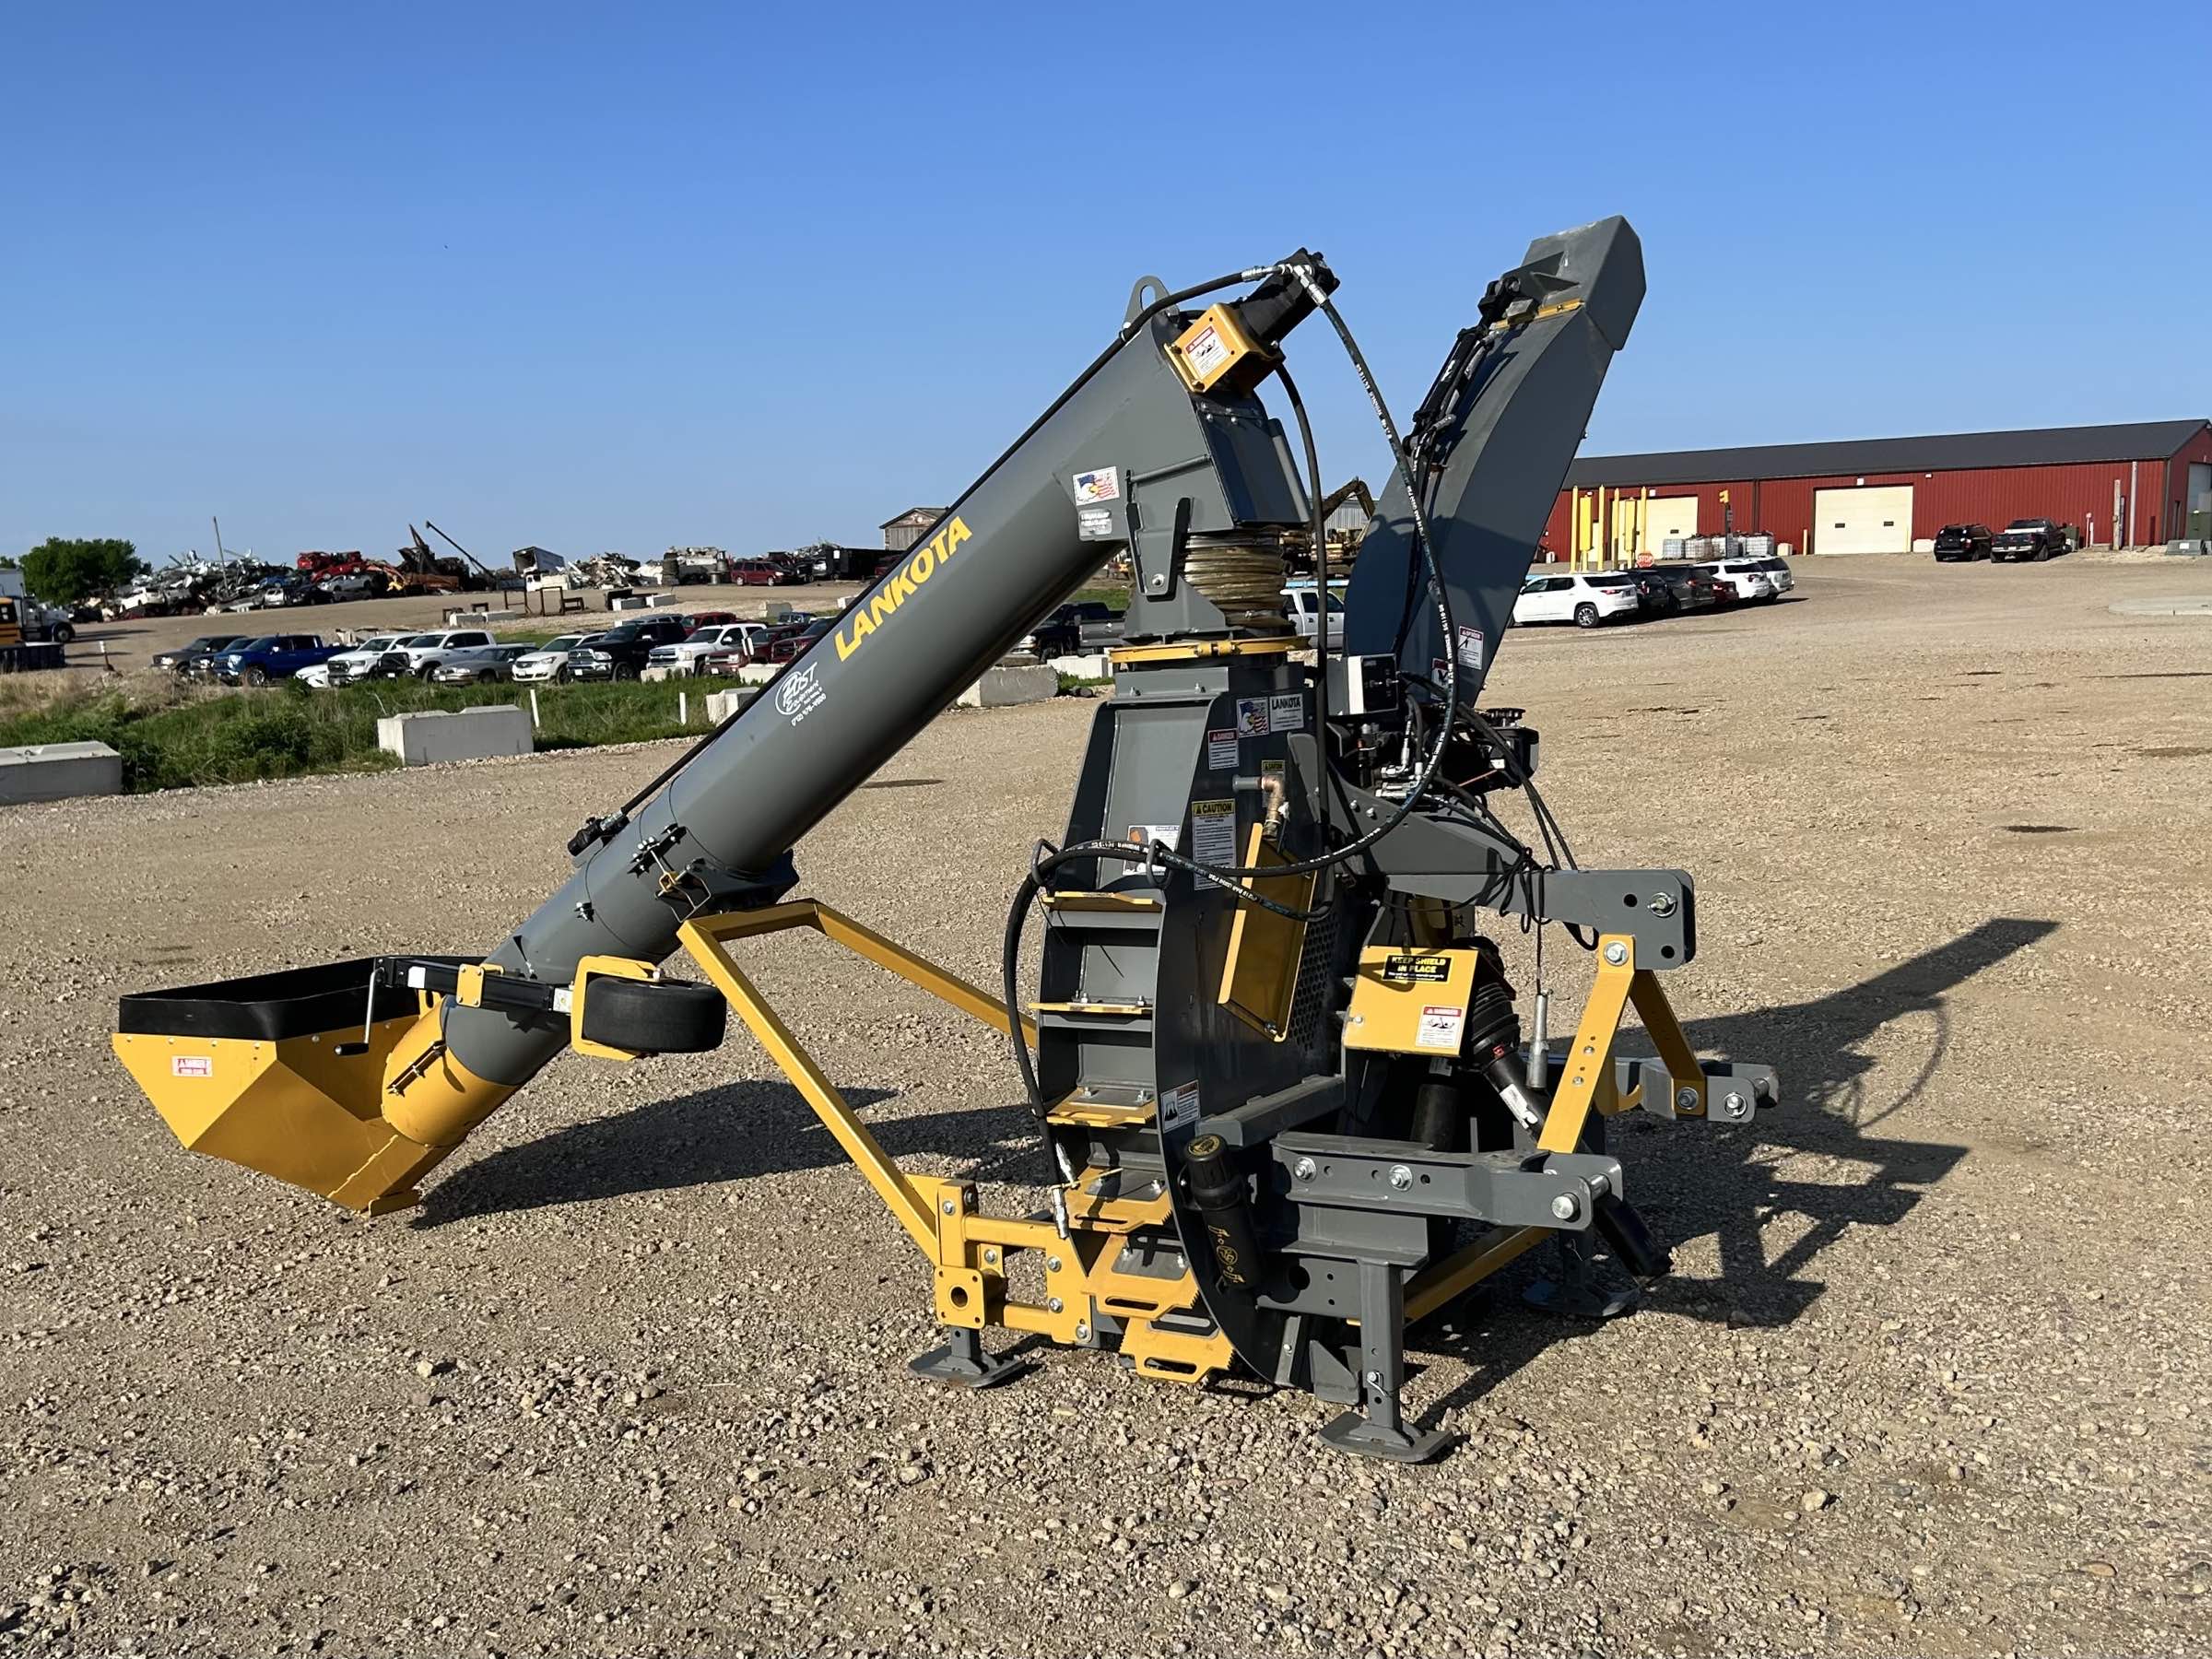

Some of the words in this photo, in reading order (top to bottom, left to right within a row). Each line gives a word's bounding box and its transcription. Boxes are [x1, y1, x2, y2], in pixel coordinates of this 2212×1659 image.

[835, 515, 973, 662] LANKOTA
[1272, 696, 1300, 710] LANKOTA
[1202, 803, 1232, 814] CAUTION
[1415, 958, 1446, 966] SHIELD
[1409, 965, 1438, 973] PLACE
